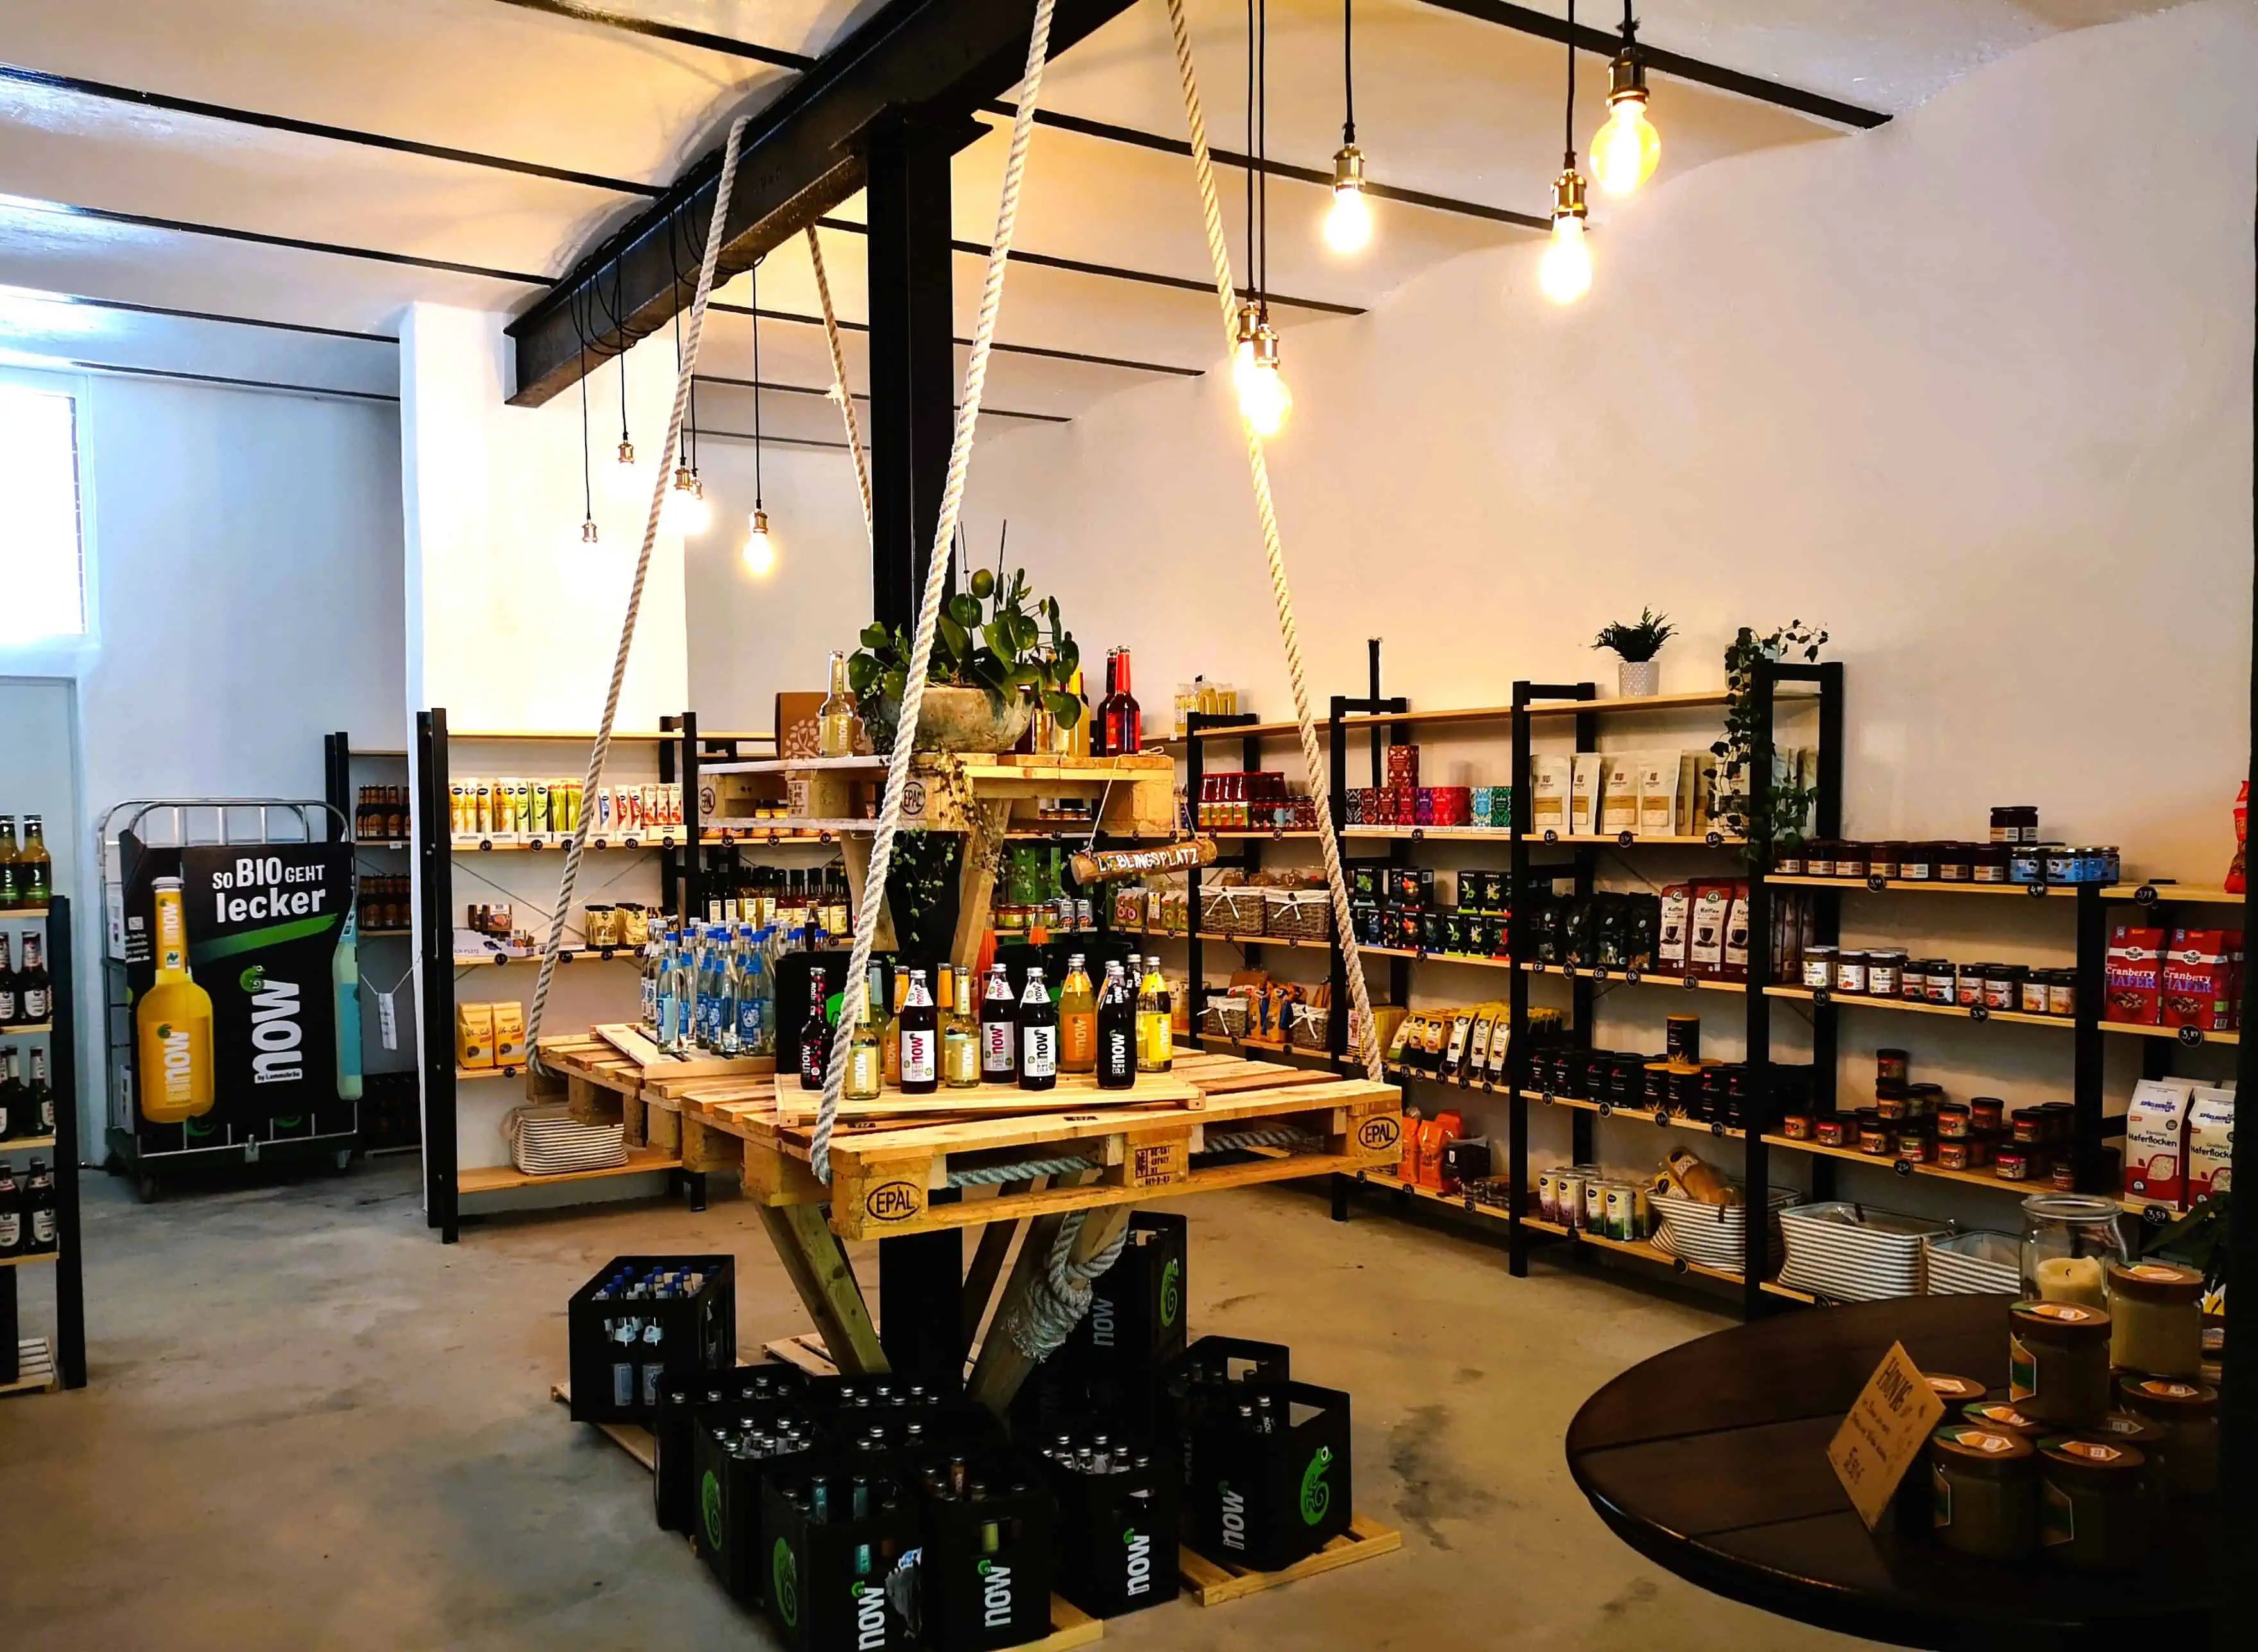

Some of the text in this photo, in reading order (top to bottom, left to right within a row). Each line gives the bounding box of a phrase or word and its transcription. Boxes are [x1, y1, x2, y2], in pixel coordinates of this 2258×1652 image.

[212, 857, 325, 889] SO BIO GEHT
[216, 887, 326, 923] lecker
[2105, 967, 2156, 979] Cranberry
[2163, 970, 2211, 984] Cranberry
[251, 979, 303, 1084] now
[992, 1027, 1004, 1054] now
[1037, 1031, 1048, 1059] now
[1076, 1019, 1087, 1046] now
[164, 1031, 191, 1083] now
[912, 1036, 924, 1065] now
[1112, 1034, 1125, 1064] now
[1365, 1123, 1393, 1143] EPAL
[2128, 1133, 2177, 1147] Haferflocken
[2190, 1145, 2231, 1158] Haferflock
[876, 1192, 914, 1213] EPAL
[1093, 1297, 1114, 1346] now
[1222, 1490, 1244, 1550] now
[1127, 1533, 1150, 1597] now
[985, 1566, 1012, 1628] now
[858, 1587, 885, 1652] now
